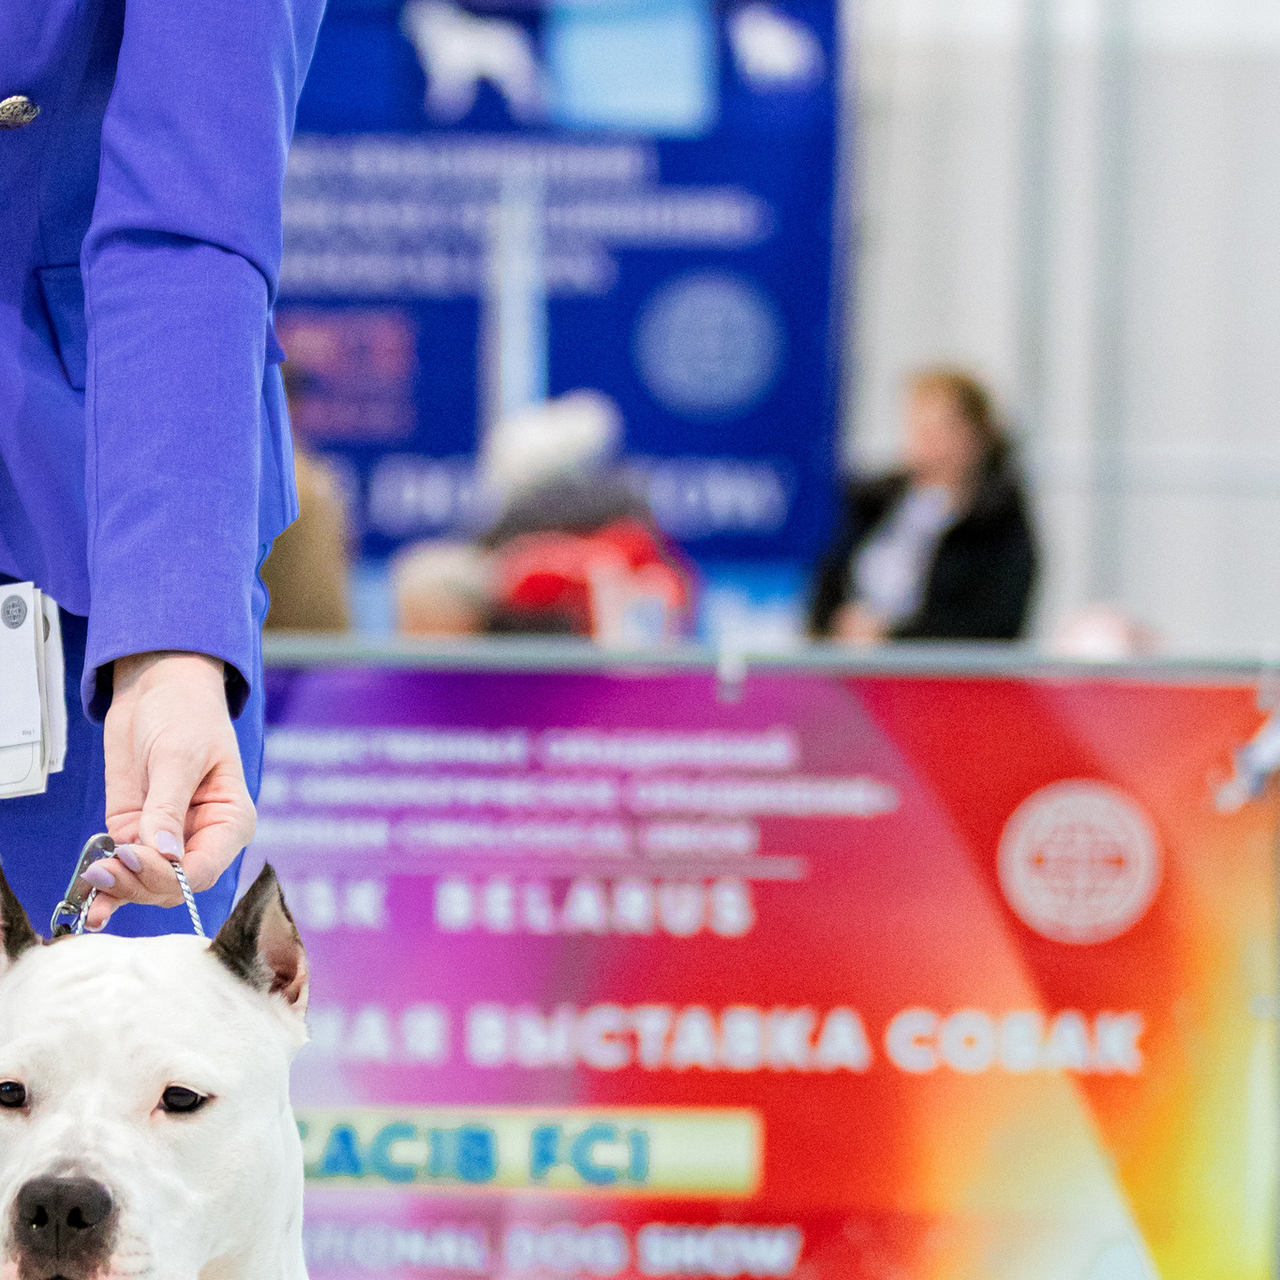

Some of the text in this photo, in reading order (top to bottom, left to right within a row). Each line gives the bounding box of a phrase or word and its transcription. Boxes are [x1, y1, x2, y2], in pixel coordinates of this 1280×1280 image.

[432, 876, 756, 937] BELARUS
[466, 1004, 872, 1074] ВЫСТАВКА
[885, 1007, 1144, 1076] СОБАК
[298, 1123, 649, 1185] ACIB FCI
[306, 1223, 804, 1277] TIONAL DOG SHOW
